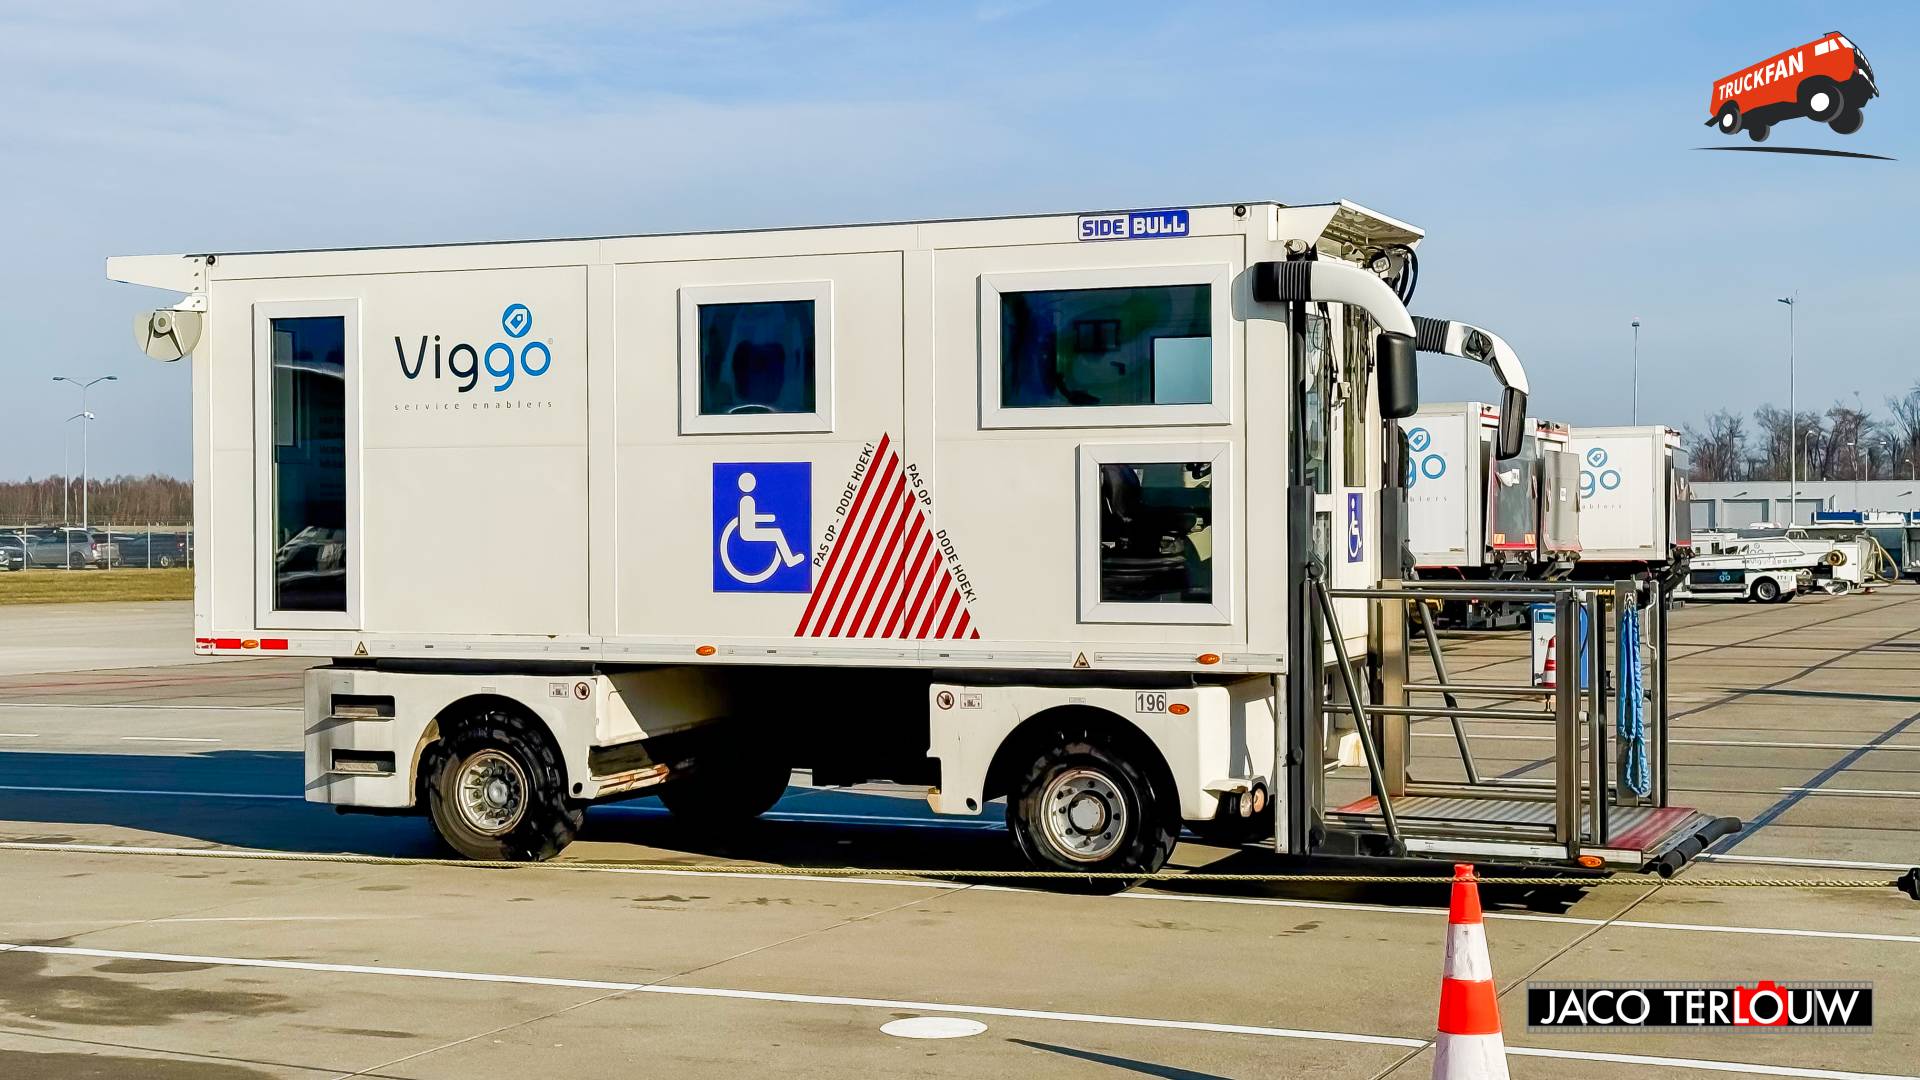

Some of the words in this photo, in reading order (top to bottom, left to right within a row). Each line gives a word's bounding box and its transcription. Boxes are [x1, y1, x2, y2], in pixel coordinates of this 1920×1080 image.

[1082, 219, 1125, 237] SIDE
[1133, 215, 1186, 235] BULL
[394, 334, 552, 393] Viggo
[394, 401, 460, 411] service
[472, 400, 552, 410] enablers
[813, 543, 830, 568] PAS
[824, 524, 837, 543] OP
[836, 481, 858, 516] DODE
[851, 442, 875, 482] HOEK!
[906, 463, 924, 488] PAS
[918, 489, 932, 506] OP
[936, 529, 959, 564] DODE
[952, 563, 977, 604] HOEK!
[1137, 693, 1165, 712] 196
